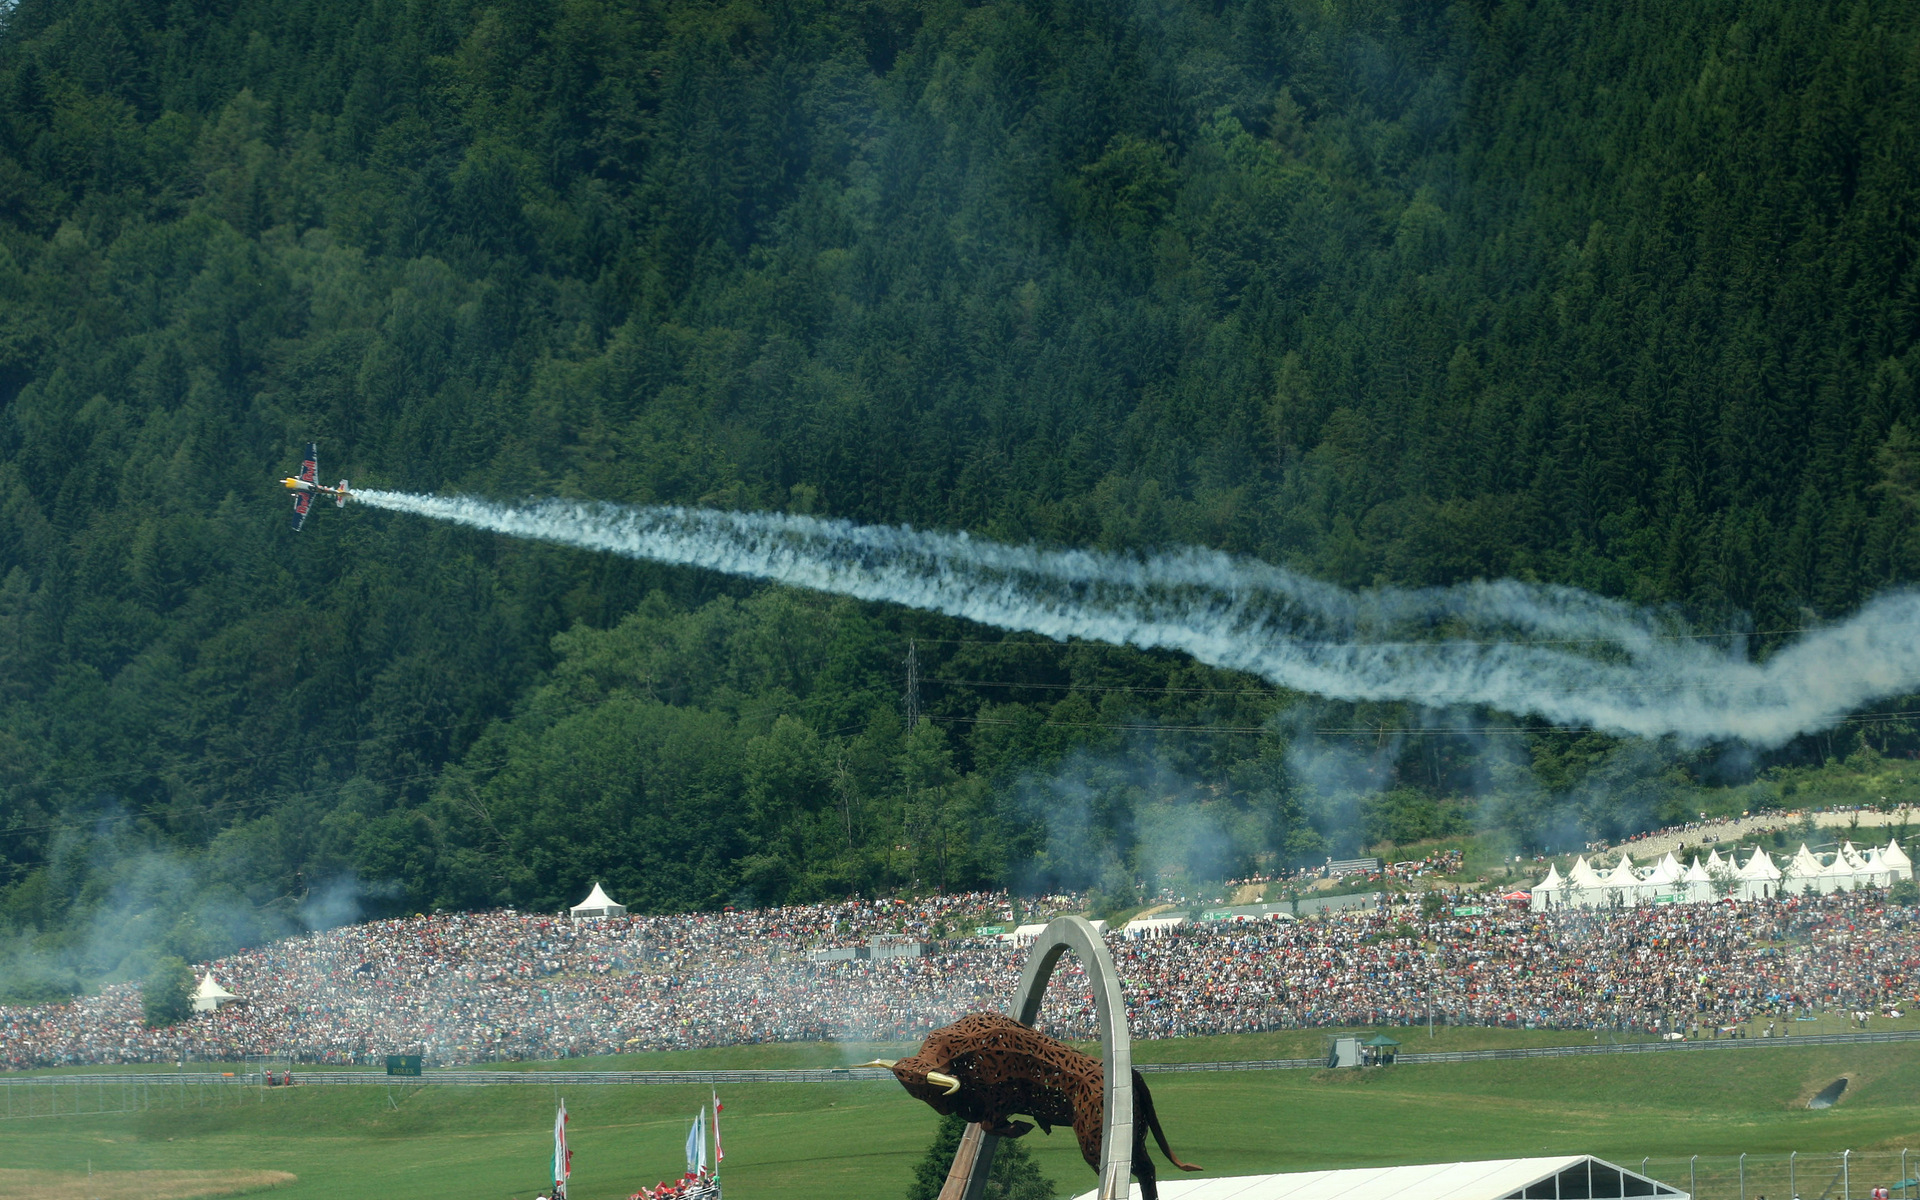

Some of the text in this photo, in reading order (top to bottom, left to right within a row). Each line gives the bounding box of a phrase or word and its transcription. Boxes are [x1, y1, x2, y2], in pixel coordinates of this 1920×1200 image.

[296, 460, 316, 514] Red Bull
[392, 1067, 415, 1075] ROLEX
